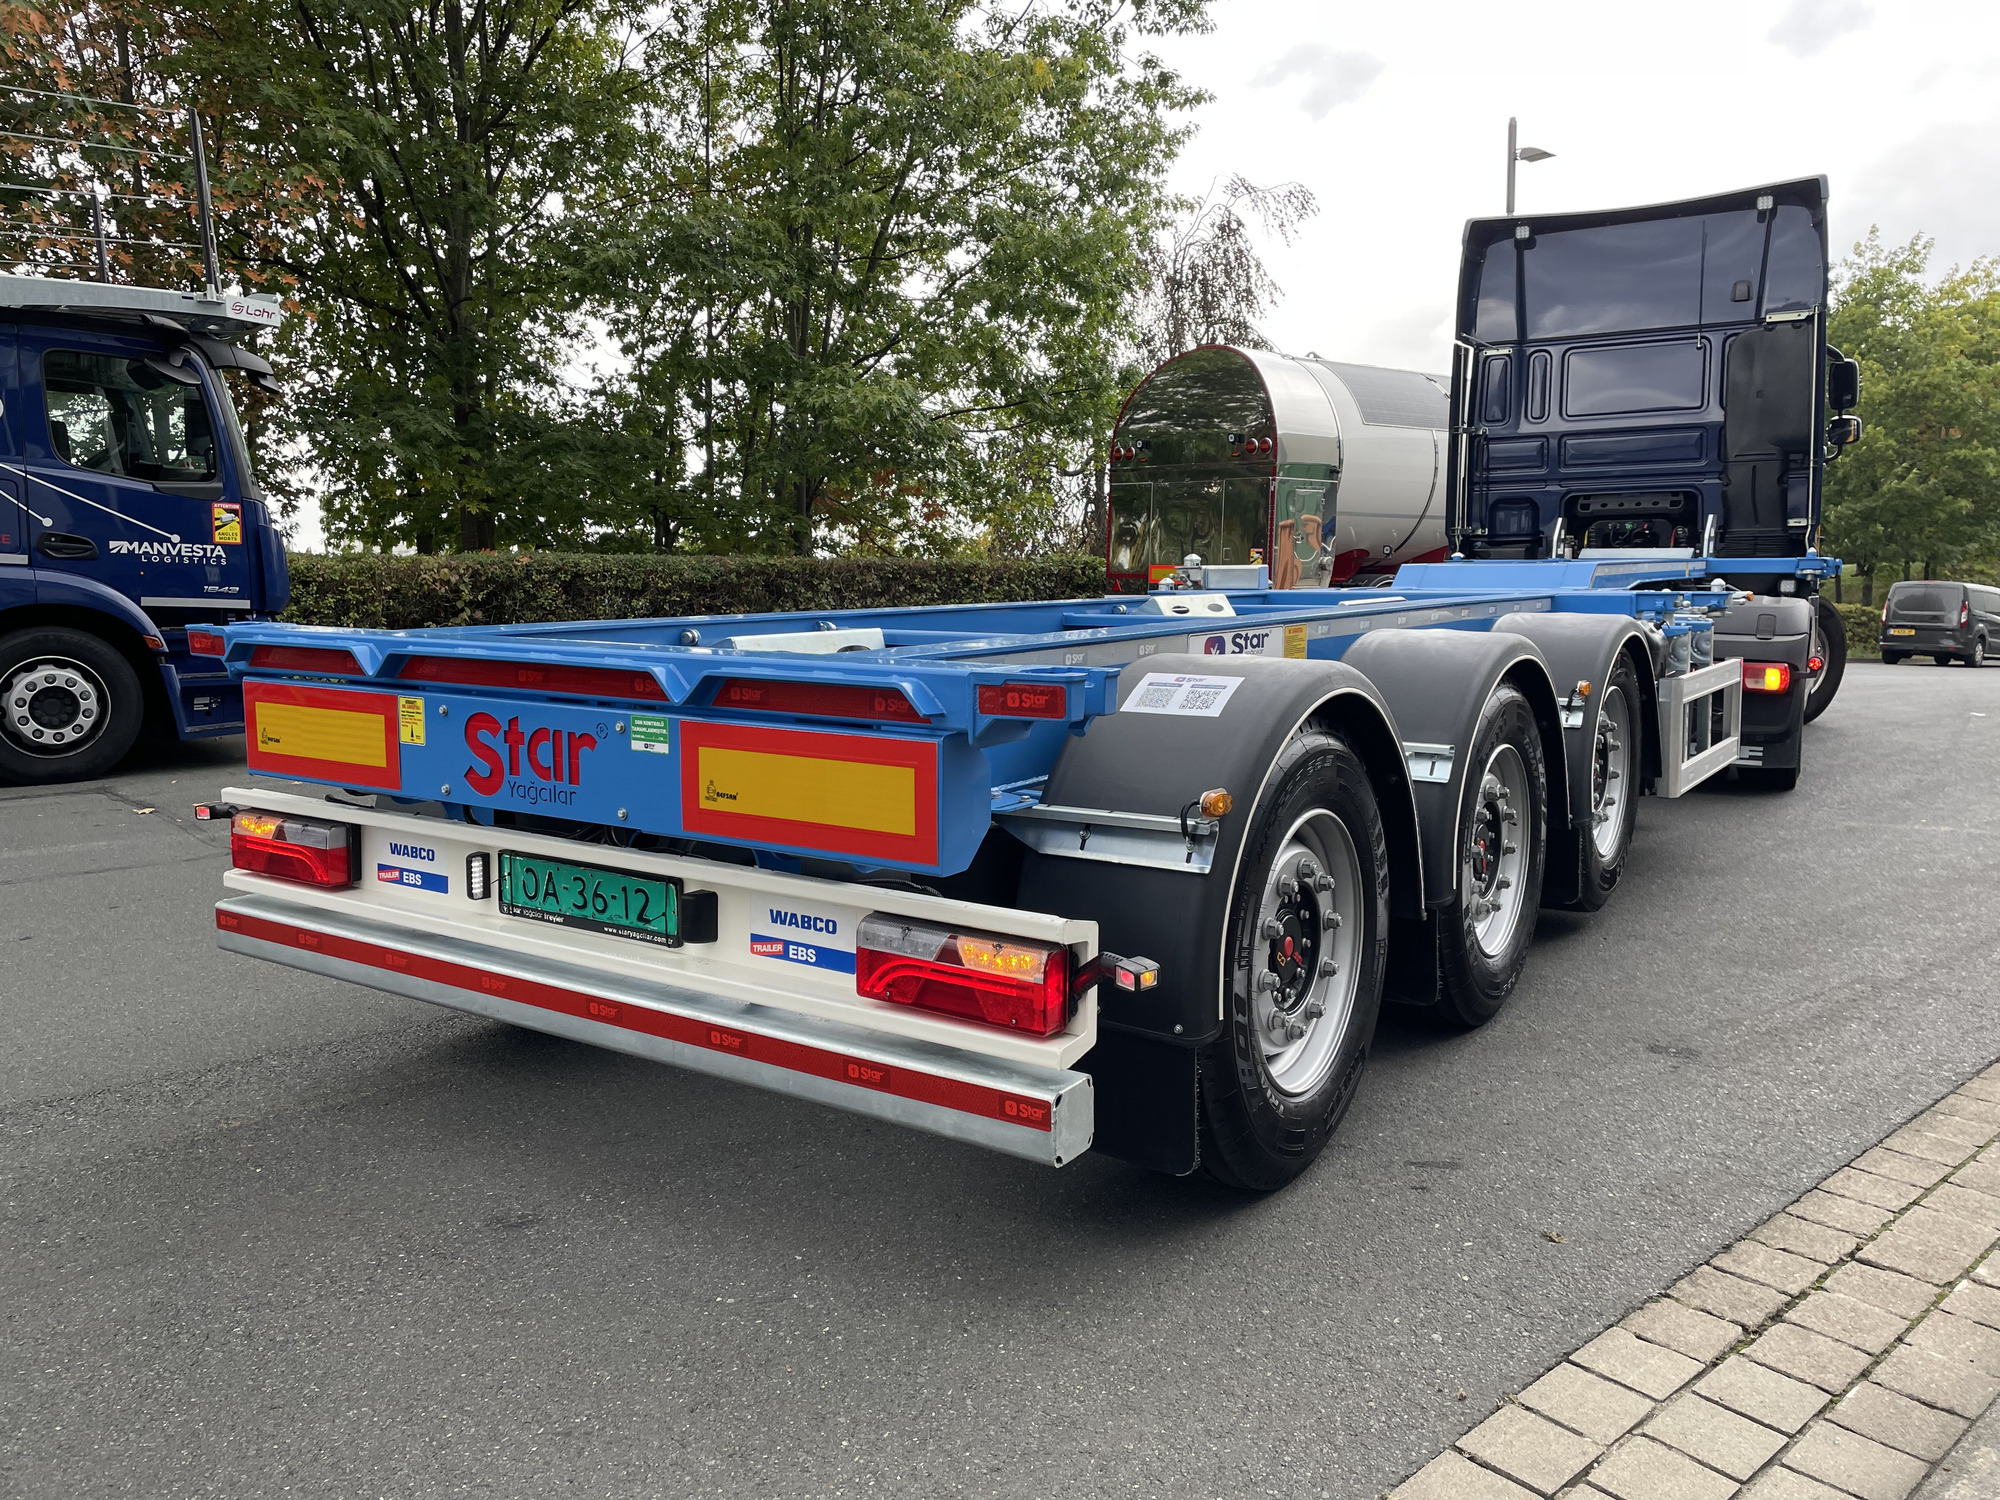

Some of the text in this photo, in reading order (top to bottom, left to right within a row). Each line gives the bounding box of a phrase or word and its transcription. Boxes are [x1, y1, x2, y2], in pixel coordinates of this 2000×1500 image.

[245, 305, 276, 319] Lohr
[121, 541, 227, 558] MANVESTA
[141, 555, 227, 566] LOGISTICS
[1231, 632, 1270, 655] Star
[1021, 692, 1049, 708] Star
[463, 711, 598, 797] Star
[507, 780, 577, 806] Yağcılar
[389, 842, 436, 862] WABCO
[379, 871, 422, 885] TRAILER EBS
[522, 867, 652, 925] OA-36-12
[769, 908, 838, 935] WABCO
[603, 926, 674, 945] www.staryagcilar.comtr
[752, 944, 817, 963] TRAILER EBS
[599, 1004, 620, 1017] Star
[721, 1033, 742, 1047] Star
[860, 1066, 884, 1081] Star
[1019, 1103, 1048, 1119] Star
